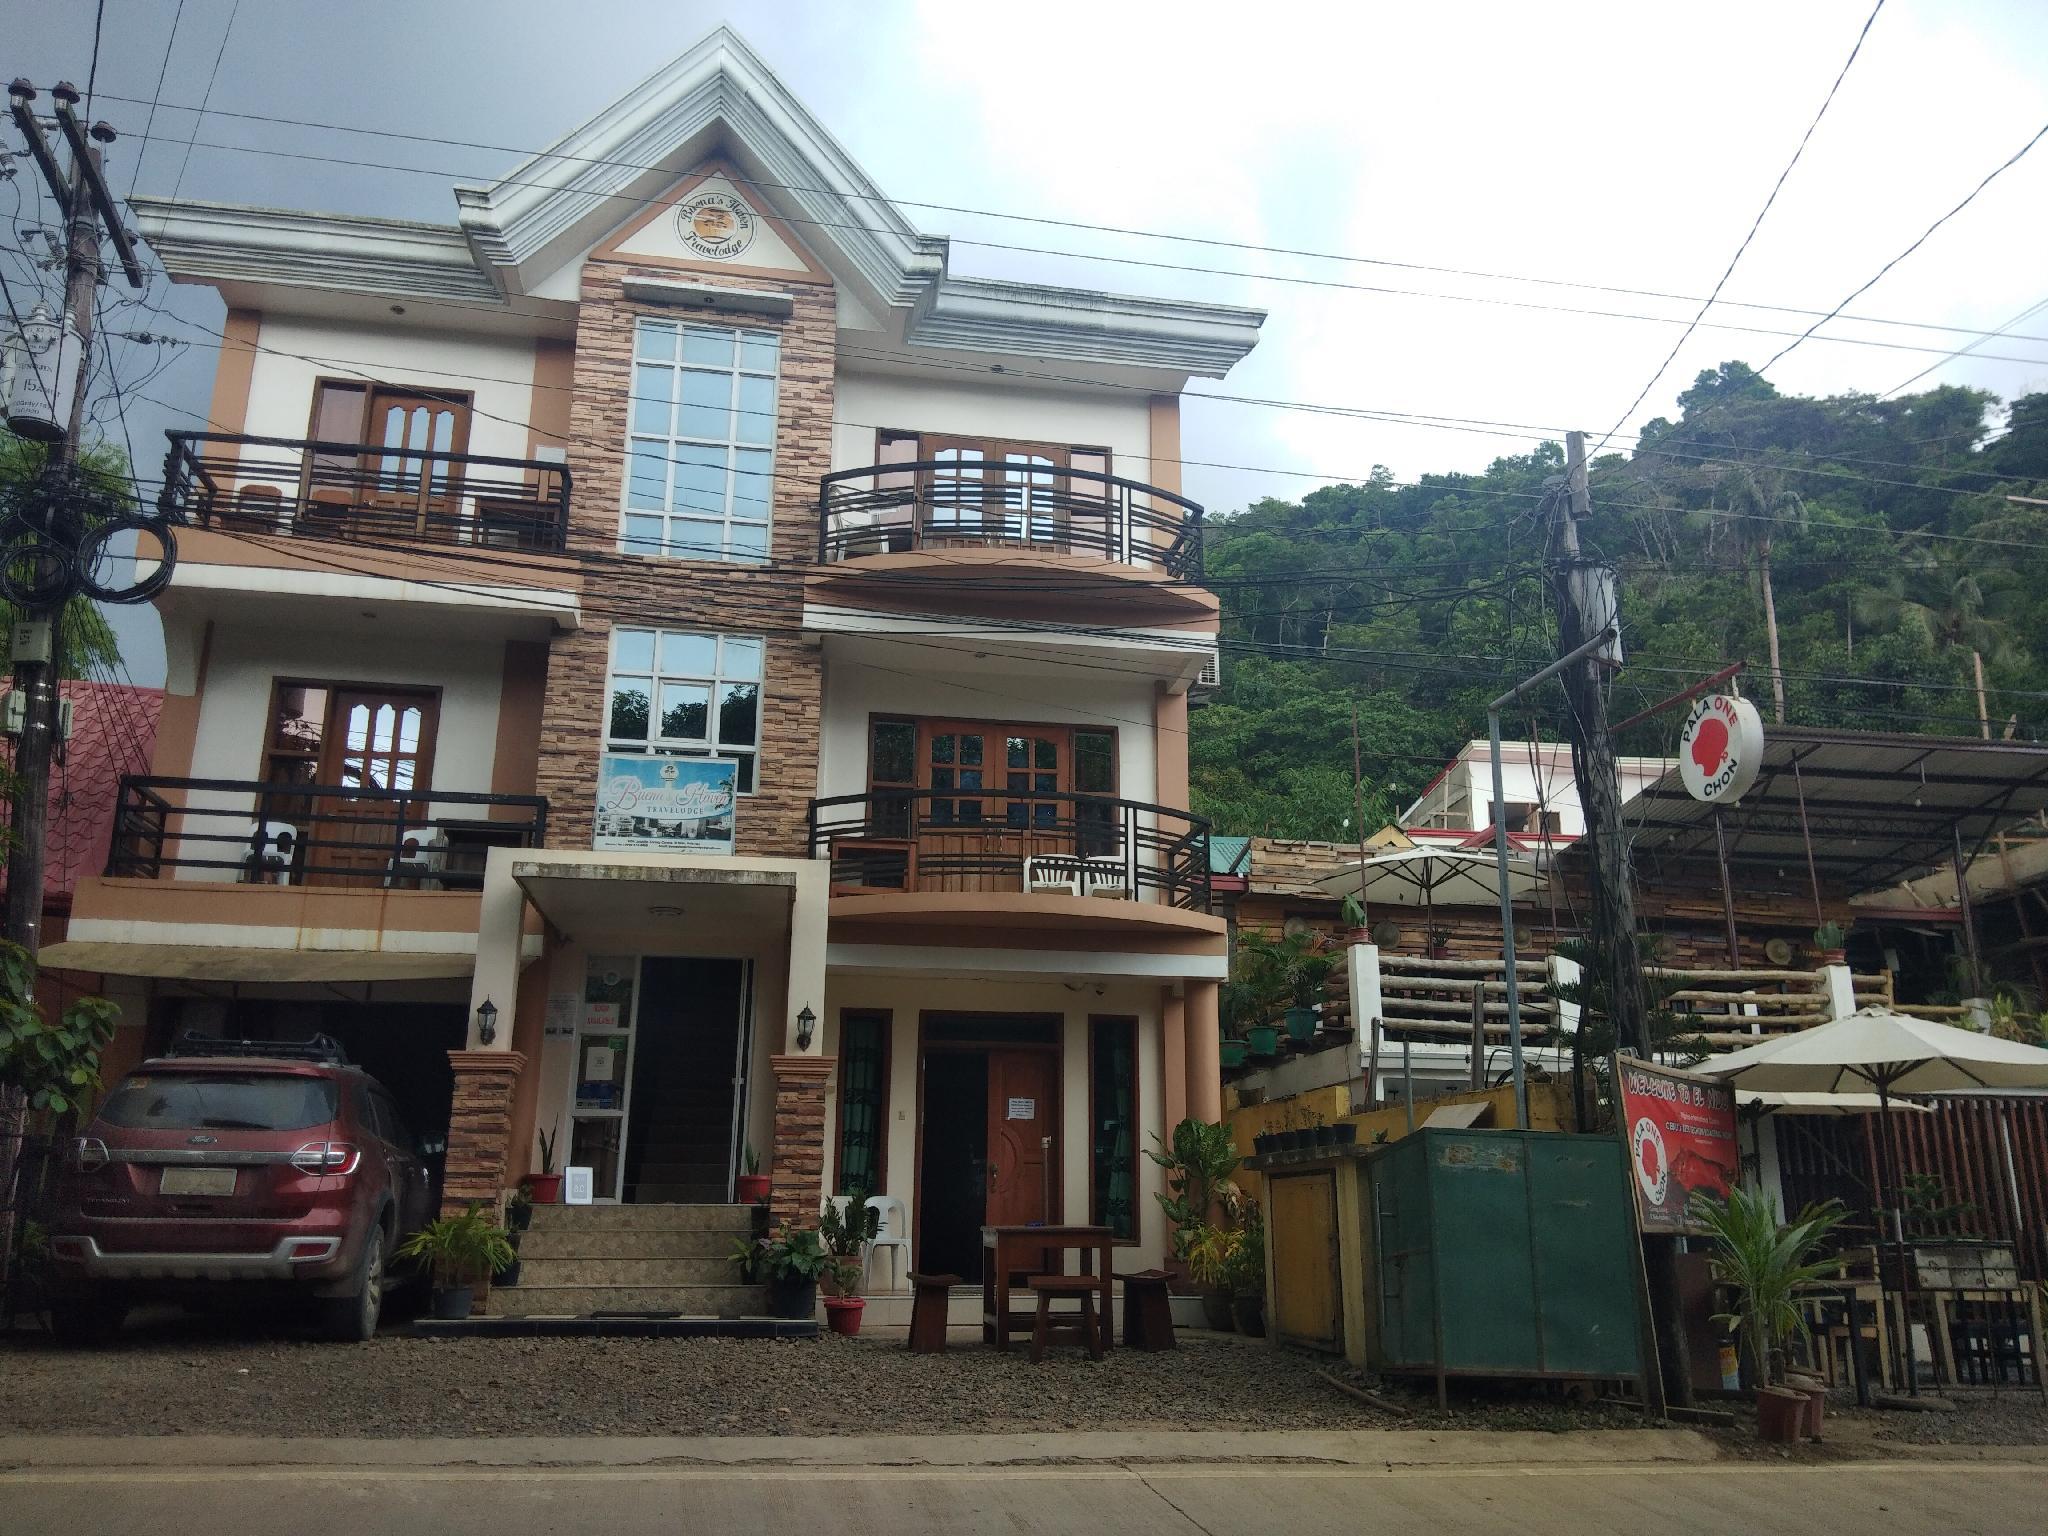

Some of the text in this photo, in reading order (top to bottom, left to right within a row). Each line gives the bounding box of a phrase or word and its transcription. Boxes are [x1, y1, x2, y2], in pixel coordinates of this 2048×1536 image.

[680, 195, 749, 229] Buena's Haven
[683, 230, 743, 256] Travelodge
[1682, 696, 1738, 743] PALA ONE
[1703, 758, 1738, 797] CHON
[647, 805, 705, 815] TRAVELODGE
[1628, 1071, 1677, 1103] WELCOME
[1677, 1082, 1690, 1105] TO
[1693, 1086, 1705, 1107] EL
[1634, 1122, 1645, 1157] PALA
[1645, 1121, 1661, 1146] ONE
